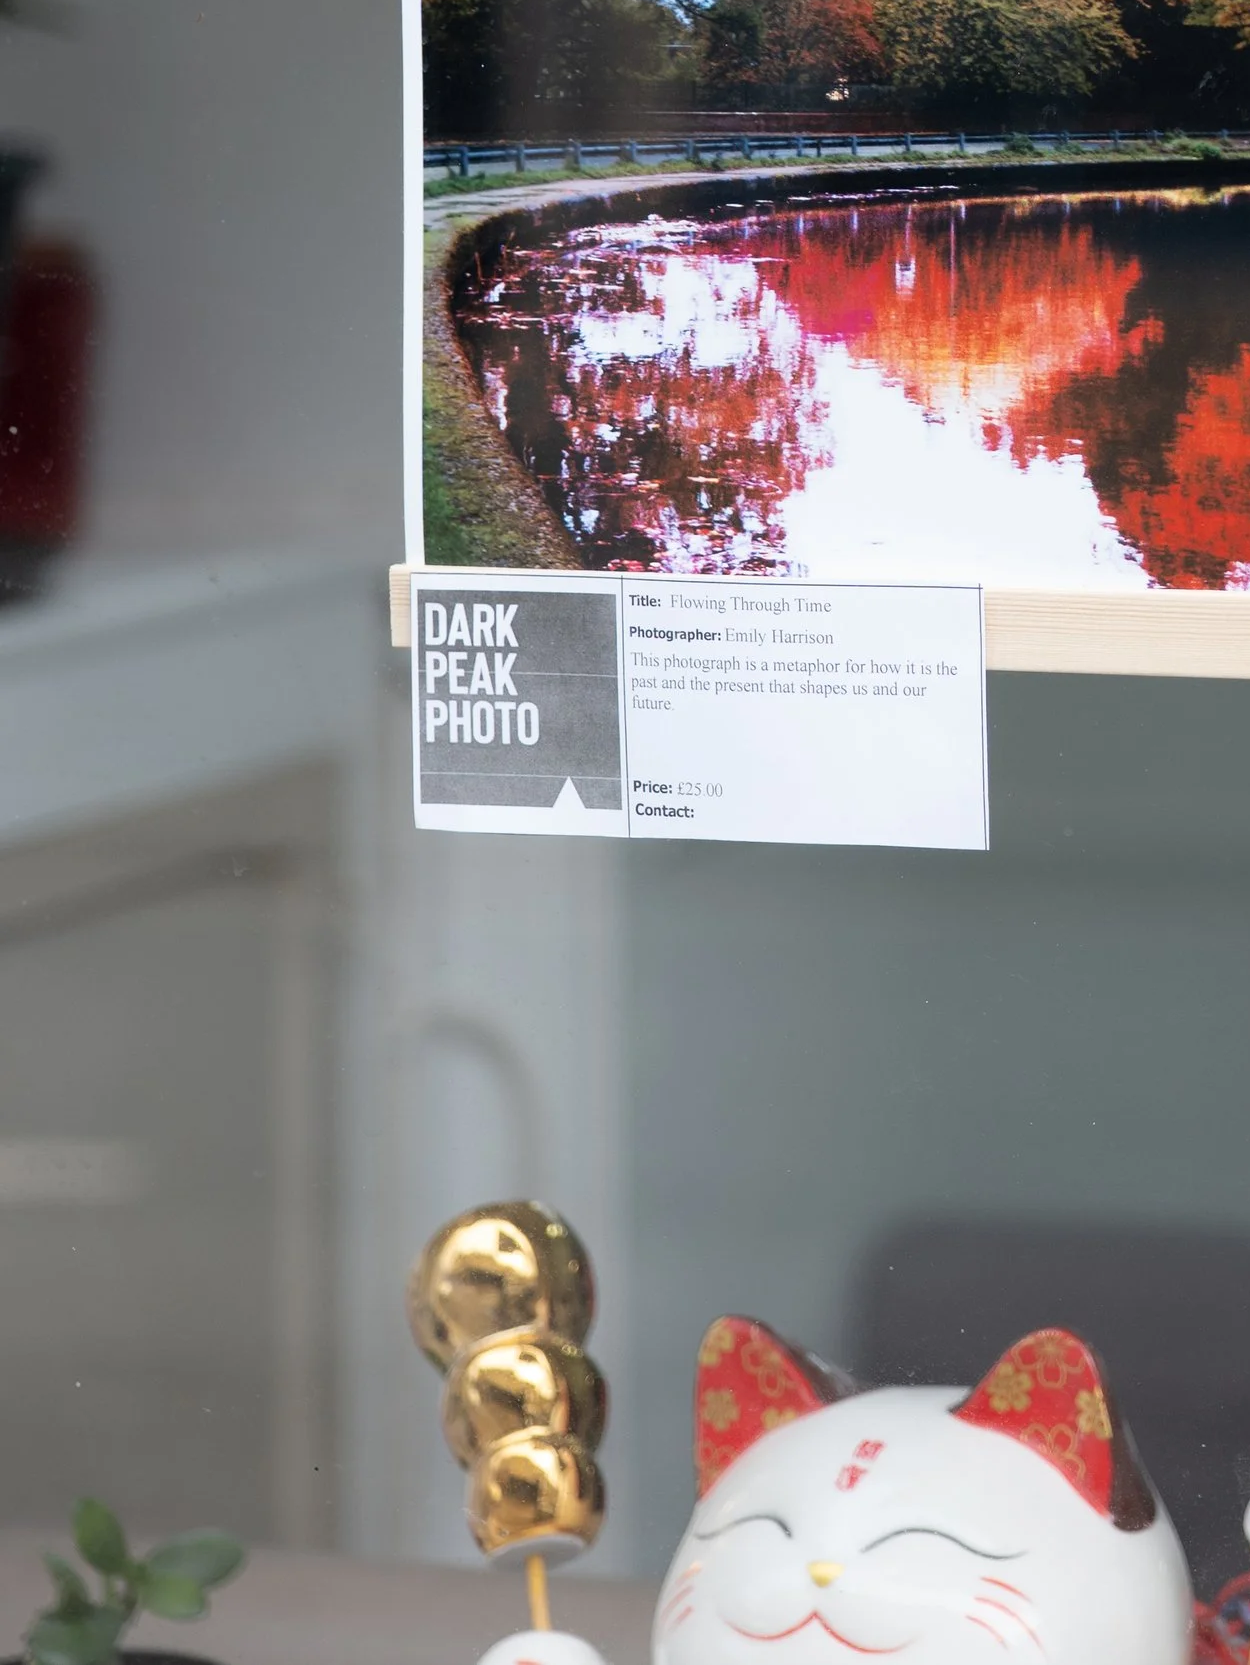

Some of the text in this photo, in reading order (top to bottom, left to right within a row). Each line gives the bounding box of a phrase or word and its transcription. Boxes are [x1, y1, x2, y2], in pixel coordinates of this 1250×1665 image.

[629, 594, 832, 615] Title: Flowing Through Time
[424, 602, 519, 647] DARK
[629, 626, 834, 646] Photographer: Emily Harrison
[425, 651, 518, 696] PEAK
[630, 652, 958, 676] This photograph is a metaphor for how it is the
[631, 676, 927, 698] past and the present that shapes us and our
[632, 695, 675, 711] future.
[425, 699, 540, 746] PHOTO
[633, 780, 723, 798] Price: £25.00
[635, 803, 694, 818] Contact:
